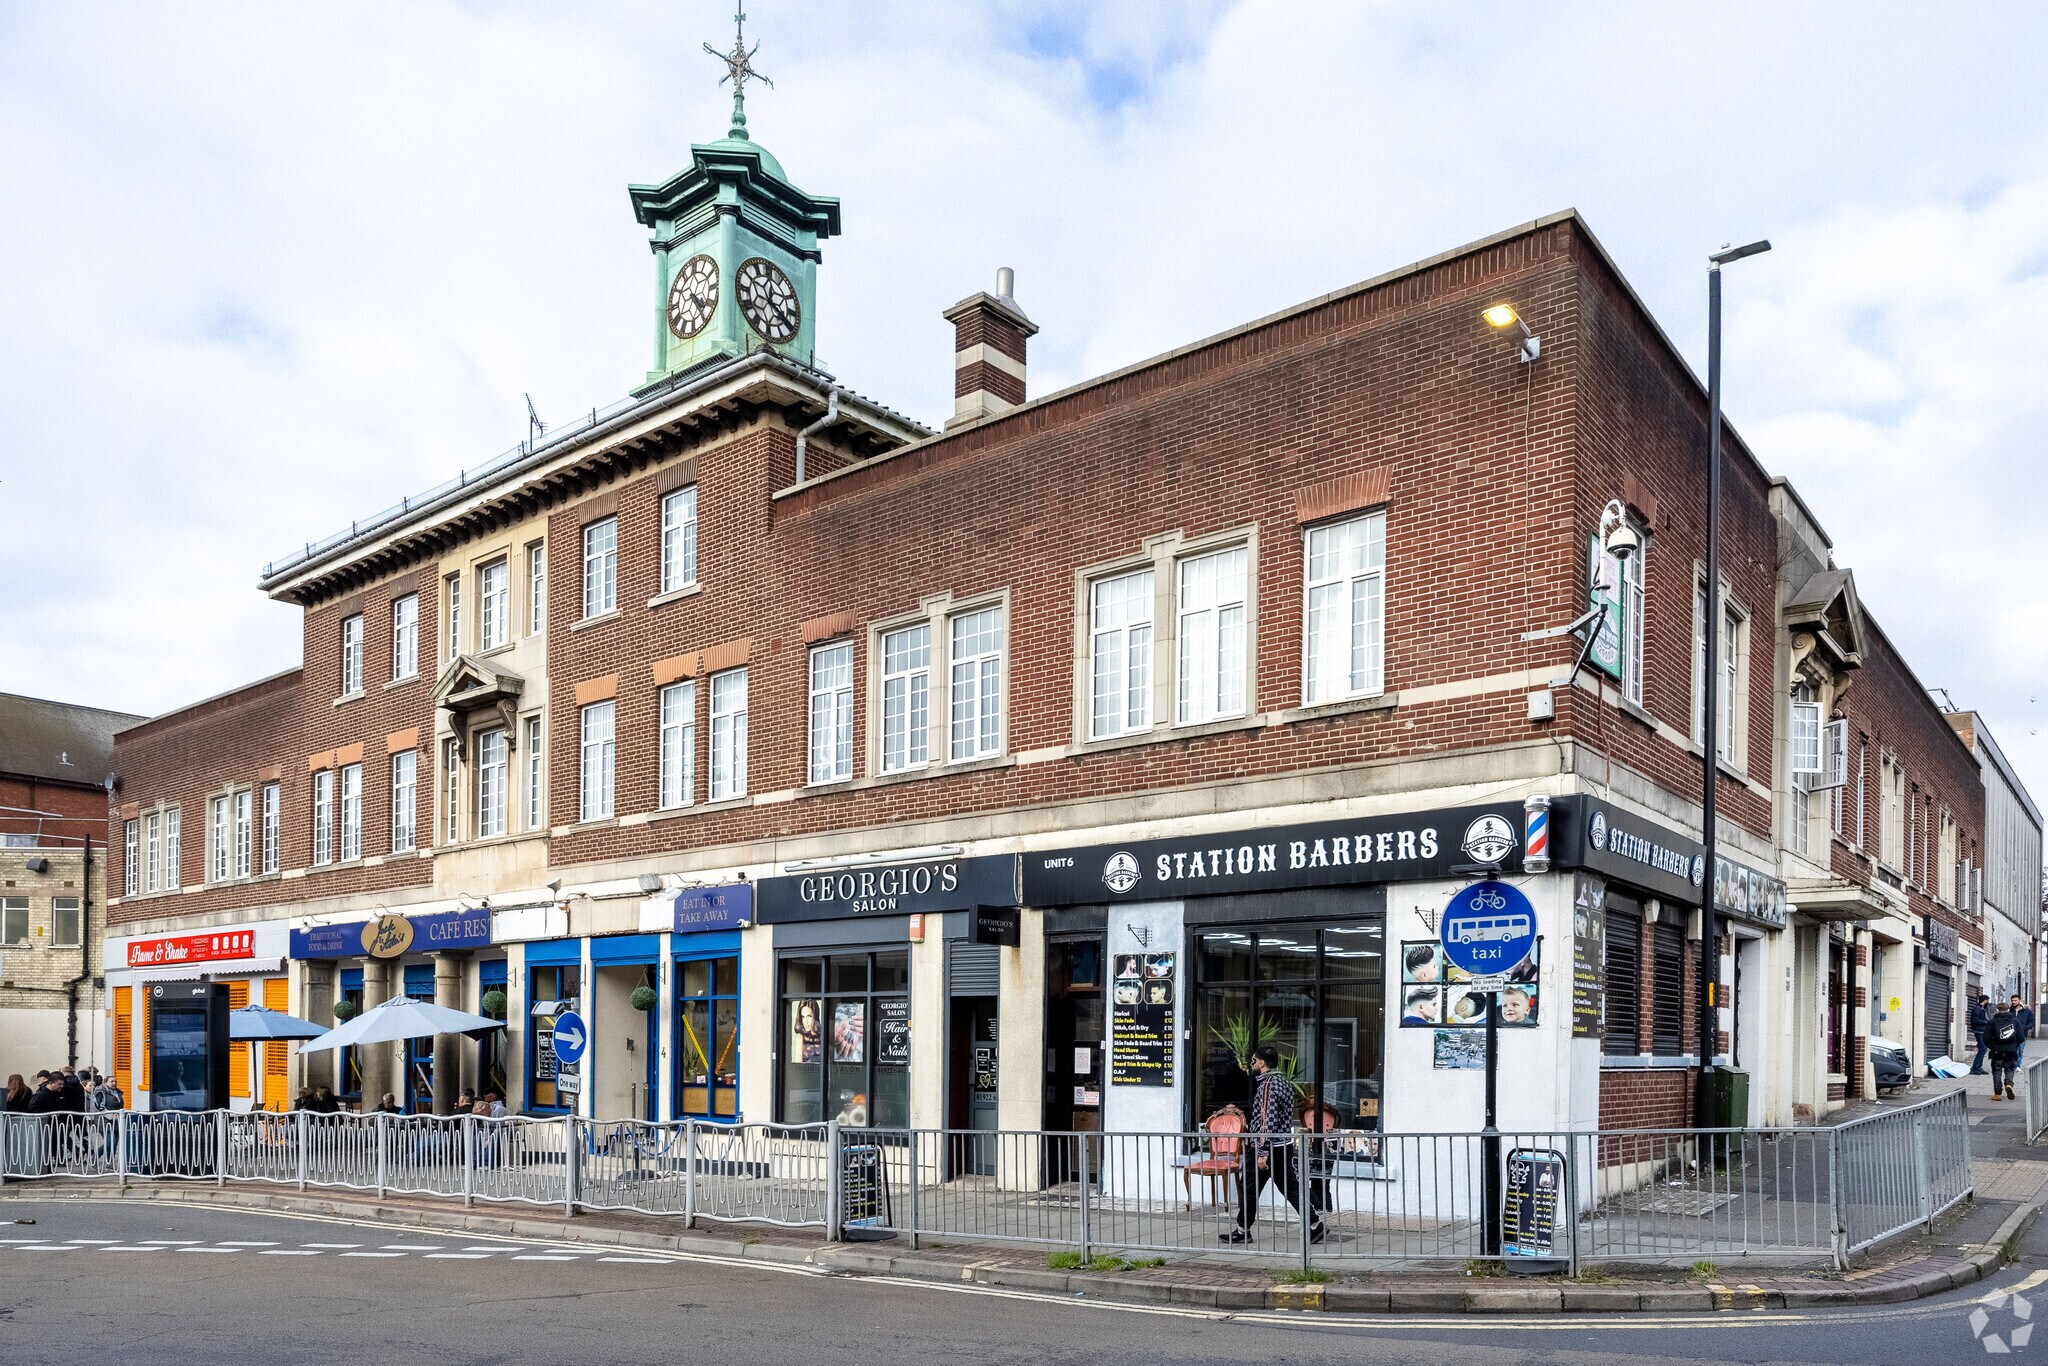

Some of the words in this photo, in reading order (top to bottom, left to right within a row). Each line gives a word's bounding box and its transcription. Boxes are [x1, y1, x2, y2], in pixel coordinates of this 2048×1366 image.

[1157, 844, 1277, 881] STATION
[1289, 828, 1439, 869] BARBERS
[1610, 827, 1651, 865] STATION
[1651, 843, 1689, 878] BARBERS
[800, 864, 958, 902] GEORGIO'S
[683, 898, 699, 910] EAT
[701, 897, 710, 908] IN
[712, 896, 725, 907] OR
[853, 898, 897, 912] SALON
[680, 912, 702, 924] TAKE
[703, 910, 729, 922] AWAY
[978, 918, 1014, 928] GEORGIO'S
[430, 915, 460, 941] CAFÉ
[309, 930, 342, 941] TRADITIONAL
[130, 945, 154, 964] Flame
[155, 943, 164, 962] &
[165, 940, 188, 961] Shake
[308, 943, 322, 952] FOOD
[327, 941, 343, 950] DRINK
[1472, 946, 1502, 960] taxi
[884, 1021, 908, 1033] Hair
[892, 1034, 902, 1044] &
[661, 1047, 666, 1058] 4
[882, 1045, 908, 1057] Nails
[560, 1078, 569, 1087] One
[569, 1081, 578, 1090] way
